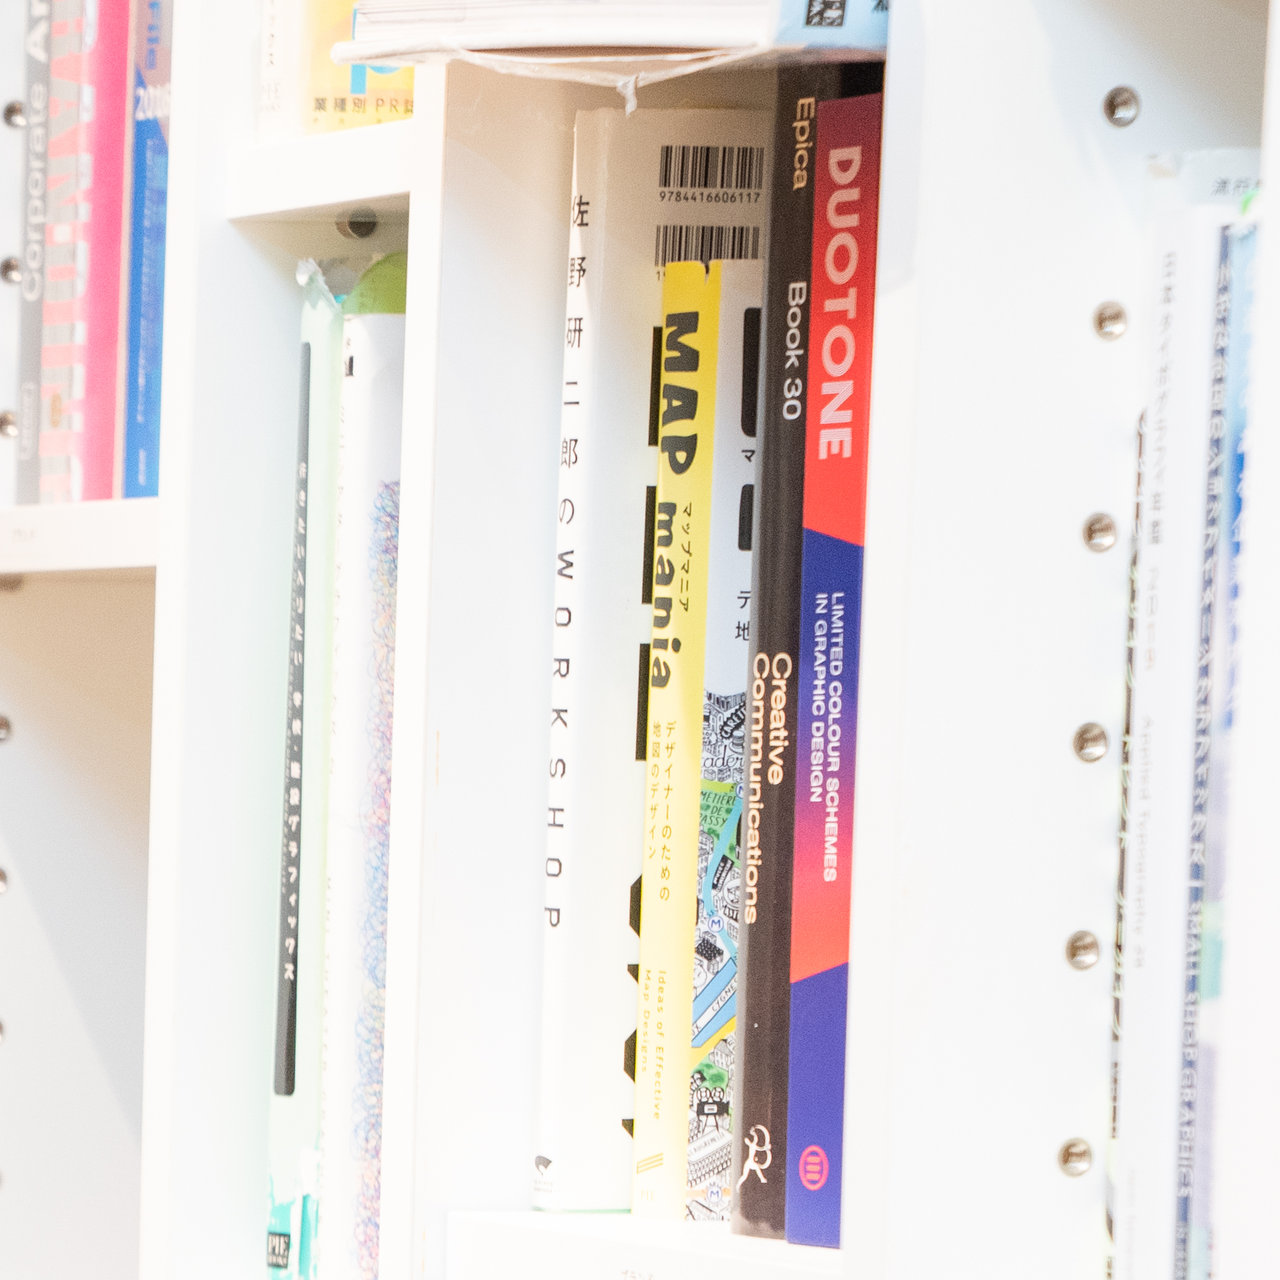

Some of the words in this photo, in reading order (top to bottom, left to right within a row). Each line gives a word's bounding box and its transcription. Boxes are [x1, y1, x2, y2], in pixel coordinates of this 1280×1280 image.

[792, 98, 816, 191] Epica
[20, 82, 48, 303] Corporate
[659, 191, 761, 204] 9784416606117
[785, 281, 807, 370] Book
[818, 145, 863, 460] DUOTONE
[661, 311, 699, 475] MAP
[782, 378, 803, 420] 30
[651, 501, 682, 689] mania
[679, 502, 692, 612] マップマニア
[815, 593, 828, 614] IN
[812, 621, 827, 715] GRAPHIC
[829, 592, 845, 676] LIMITED
[768, 652, 793, 786] Creative
[809, 719, 825, 803] DESIGN
[828, 680, 844, 774] COLOUR
[648, 722, 662, 860] 地図のデザイン
[659, 720, 677, 901] デザイナーのための
[744, 652, 771, 925] Communications
[823, 778, 840, 883] SCHEMES
[643, 969, 652, 1001] Map
[656, 1021, 665, 1038] of
[657, 970, 667, 1013] Ideas
[641, 1010, 651, 1073] Designs
[653, 1046, 665, 1120] Effective
